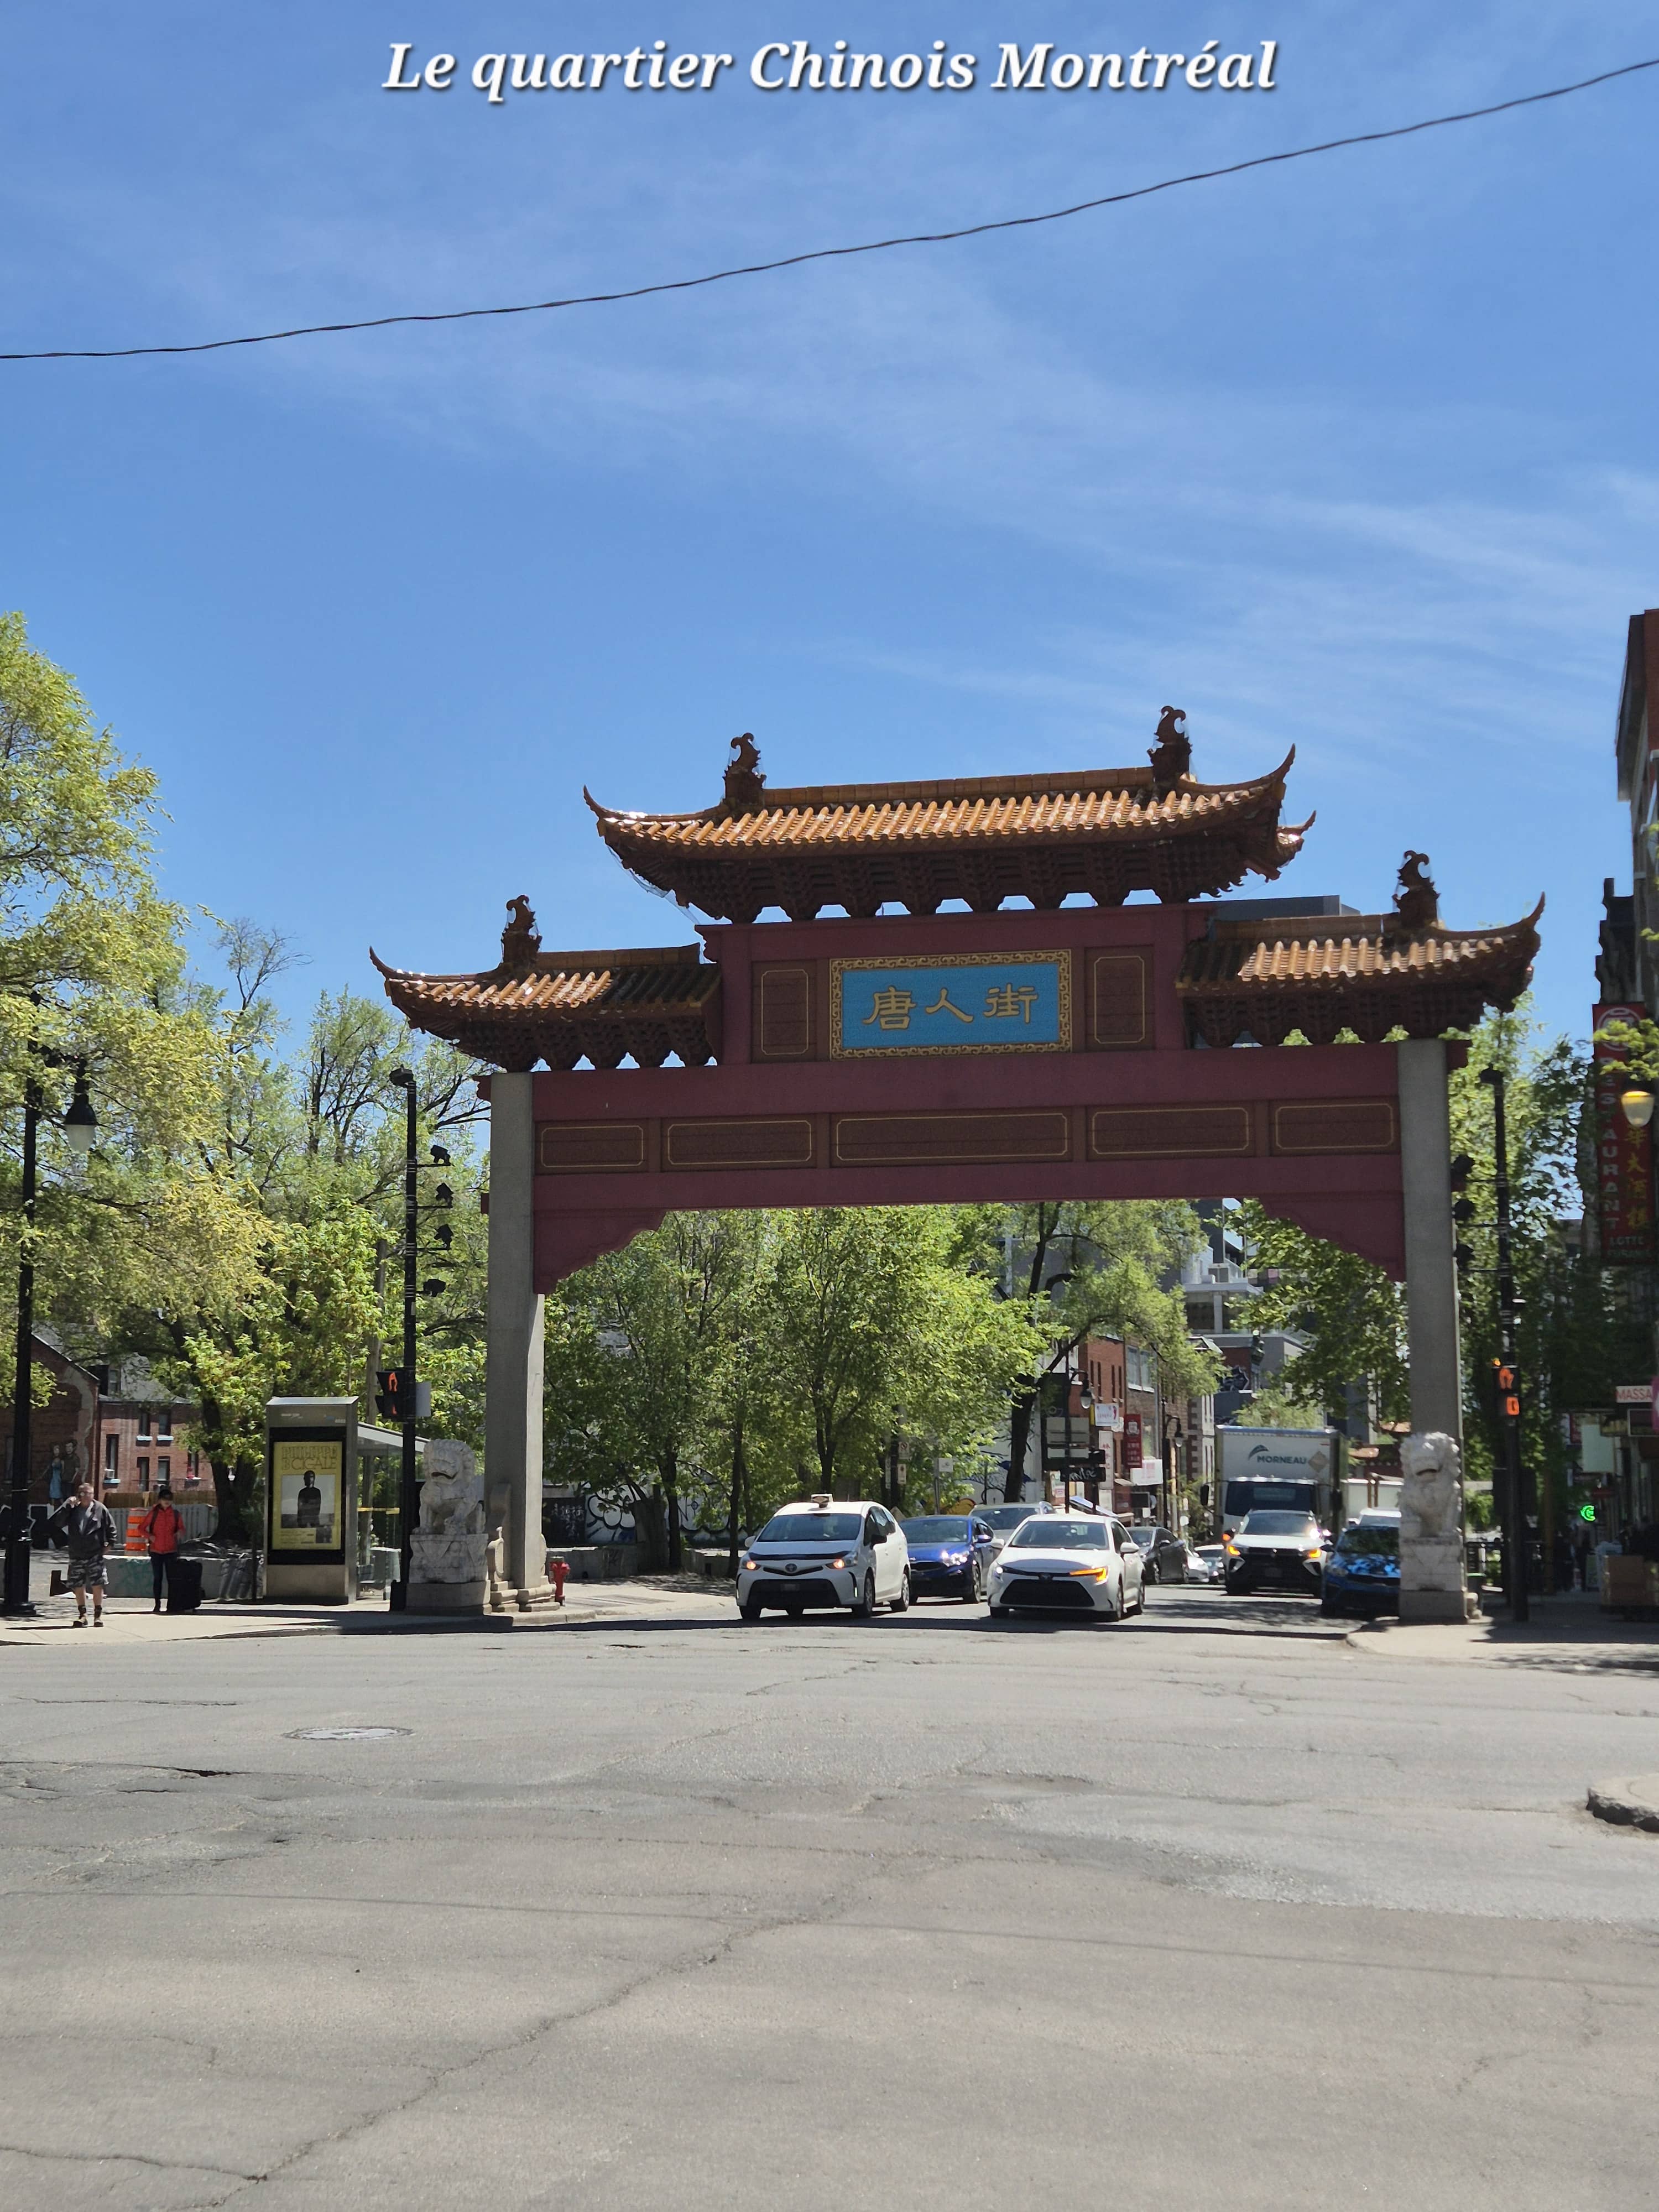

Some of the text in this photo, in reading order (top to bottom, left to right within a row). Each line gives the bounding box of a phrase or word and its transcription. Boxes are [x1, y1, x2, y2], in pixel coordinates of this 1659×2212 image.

[863, 983, 1038, 1030] 唐人街
[1256, 1455, 1307, 1465] MORNEAU
